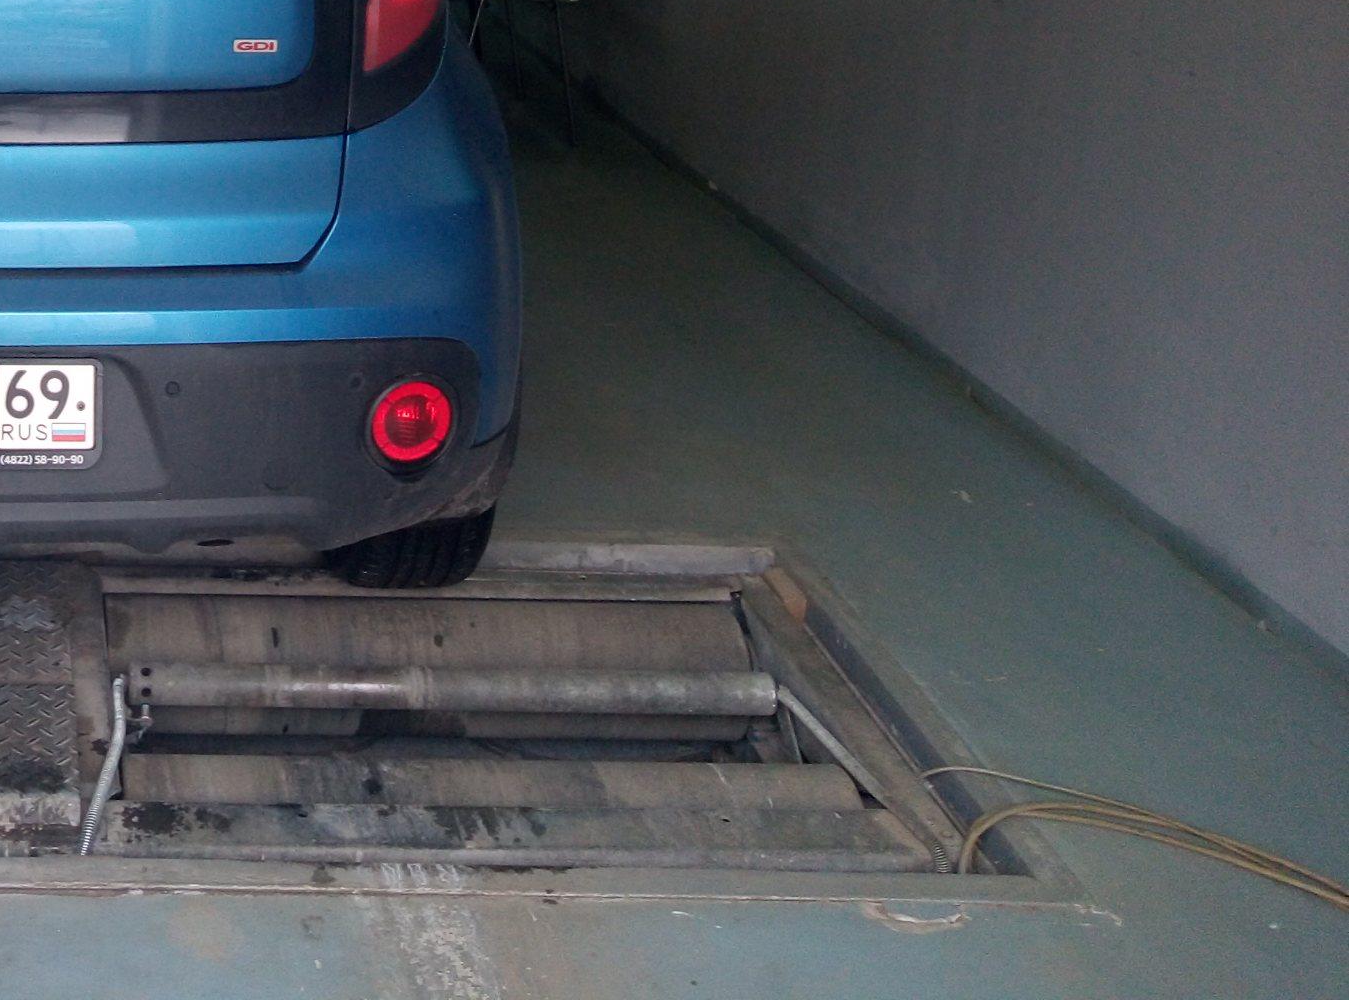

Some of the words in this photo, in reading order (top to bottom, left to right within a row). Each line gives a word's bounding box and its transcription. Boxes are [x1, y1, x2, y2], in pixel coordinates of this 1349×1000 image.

[236, 41, 275, 51] GDI
[5, 369, 70, 419] 69
[1, 423, 48, 441] RUS
[34, 455, 84, 465] 58-90-90
